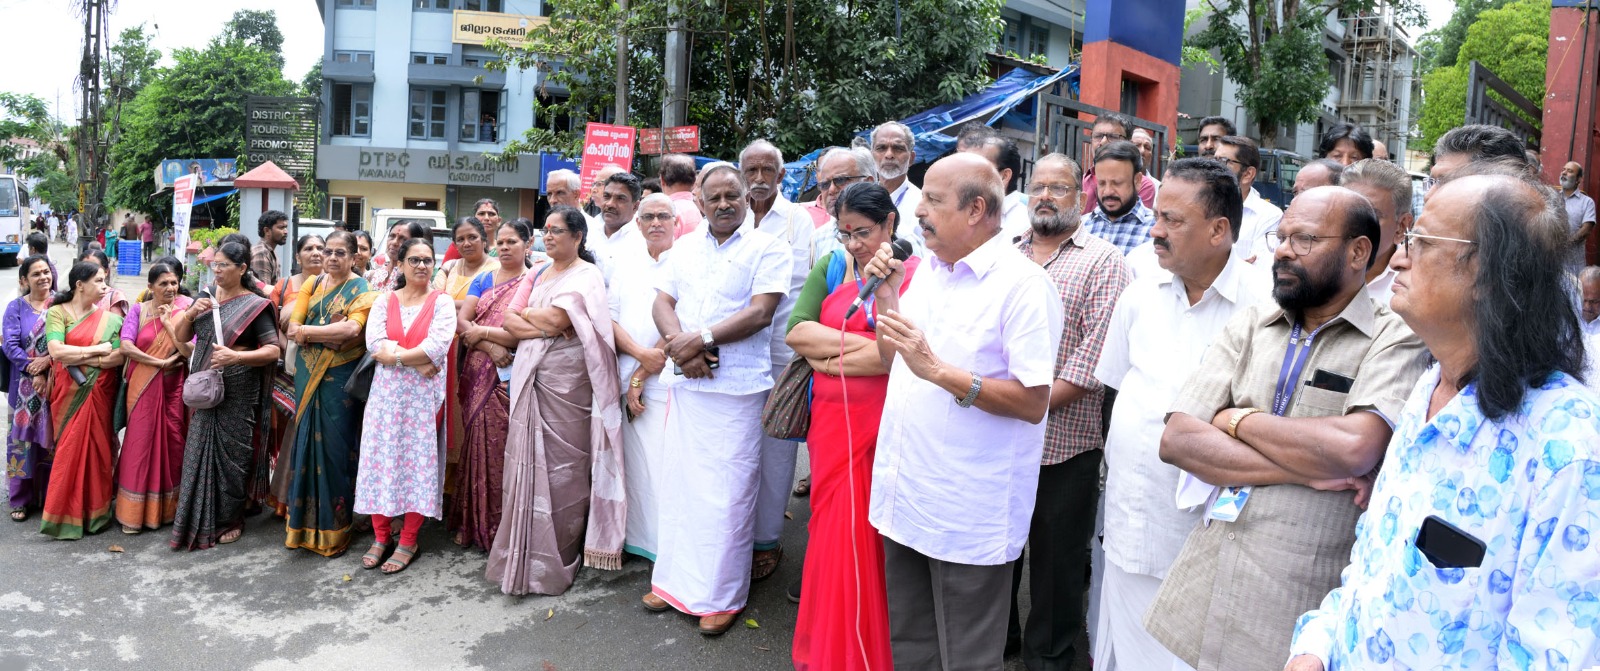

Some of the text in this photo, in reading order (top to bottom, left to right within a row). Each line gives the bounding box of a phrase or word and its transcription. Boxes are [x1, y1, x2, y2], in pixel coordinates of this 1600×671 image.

[460, 23, 490, 34] ജില്ലാ
[252, 110, 296, 121] DISTRICT
[252, 125, 296, 135] TOURISM
[360, 151, 410, 168] DTPC
[359, 168, 405, 179] WAYANAD
[448, 172, 494, 183] വയനാട്
